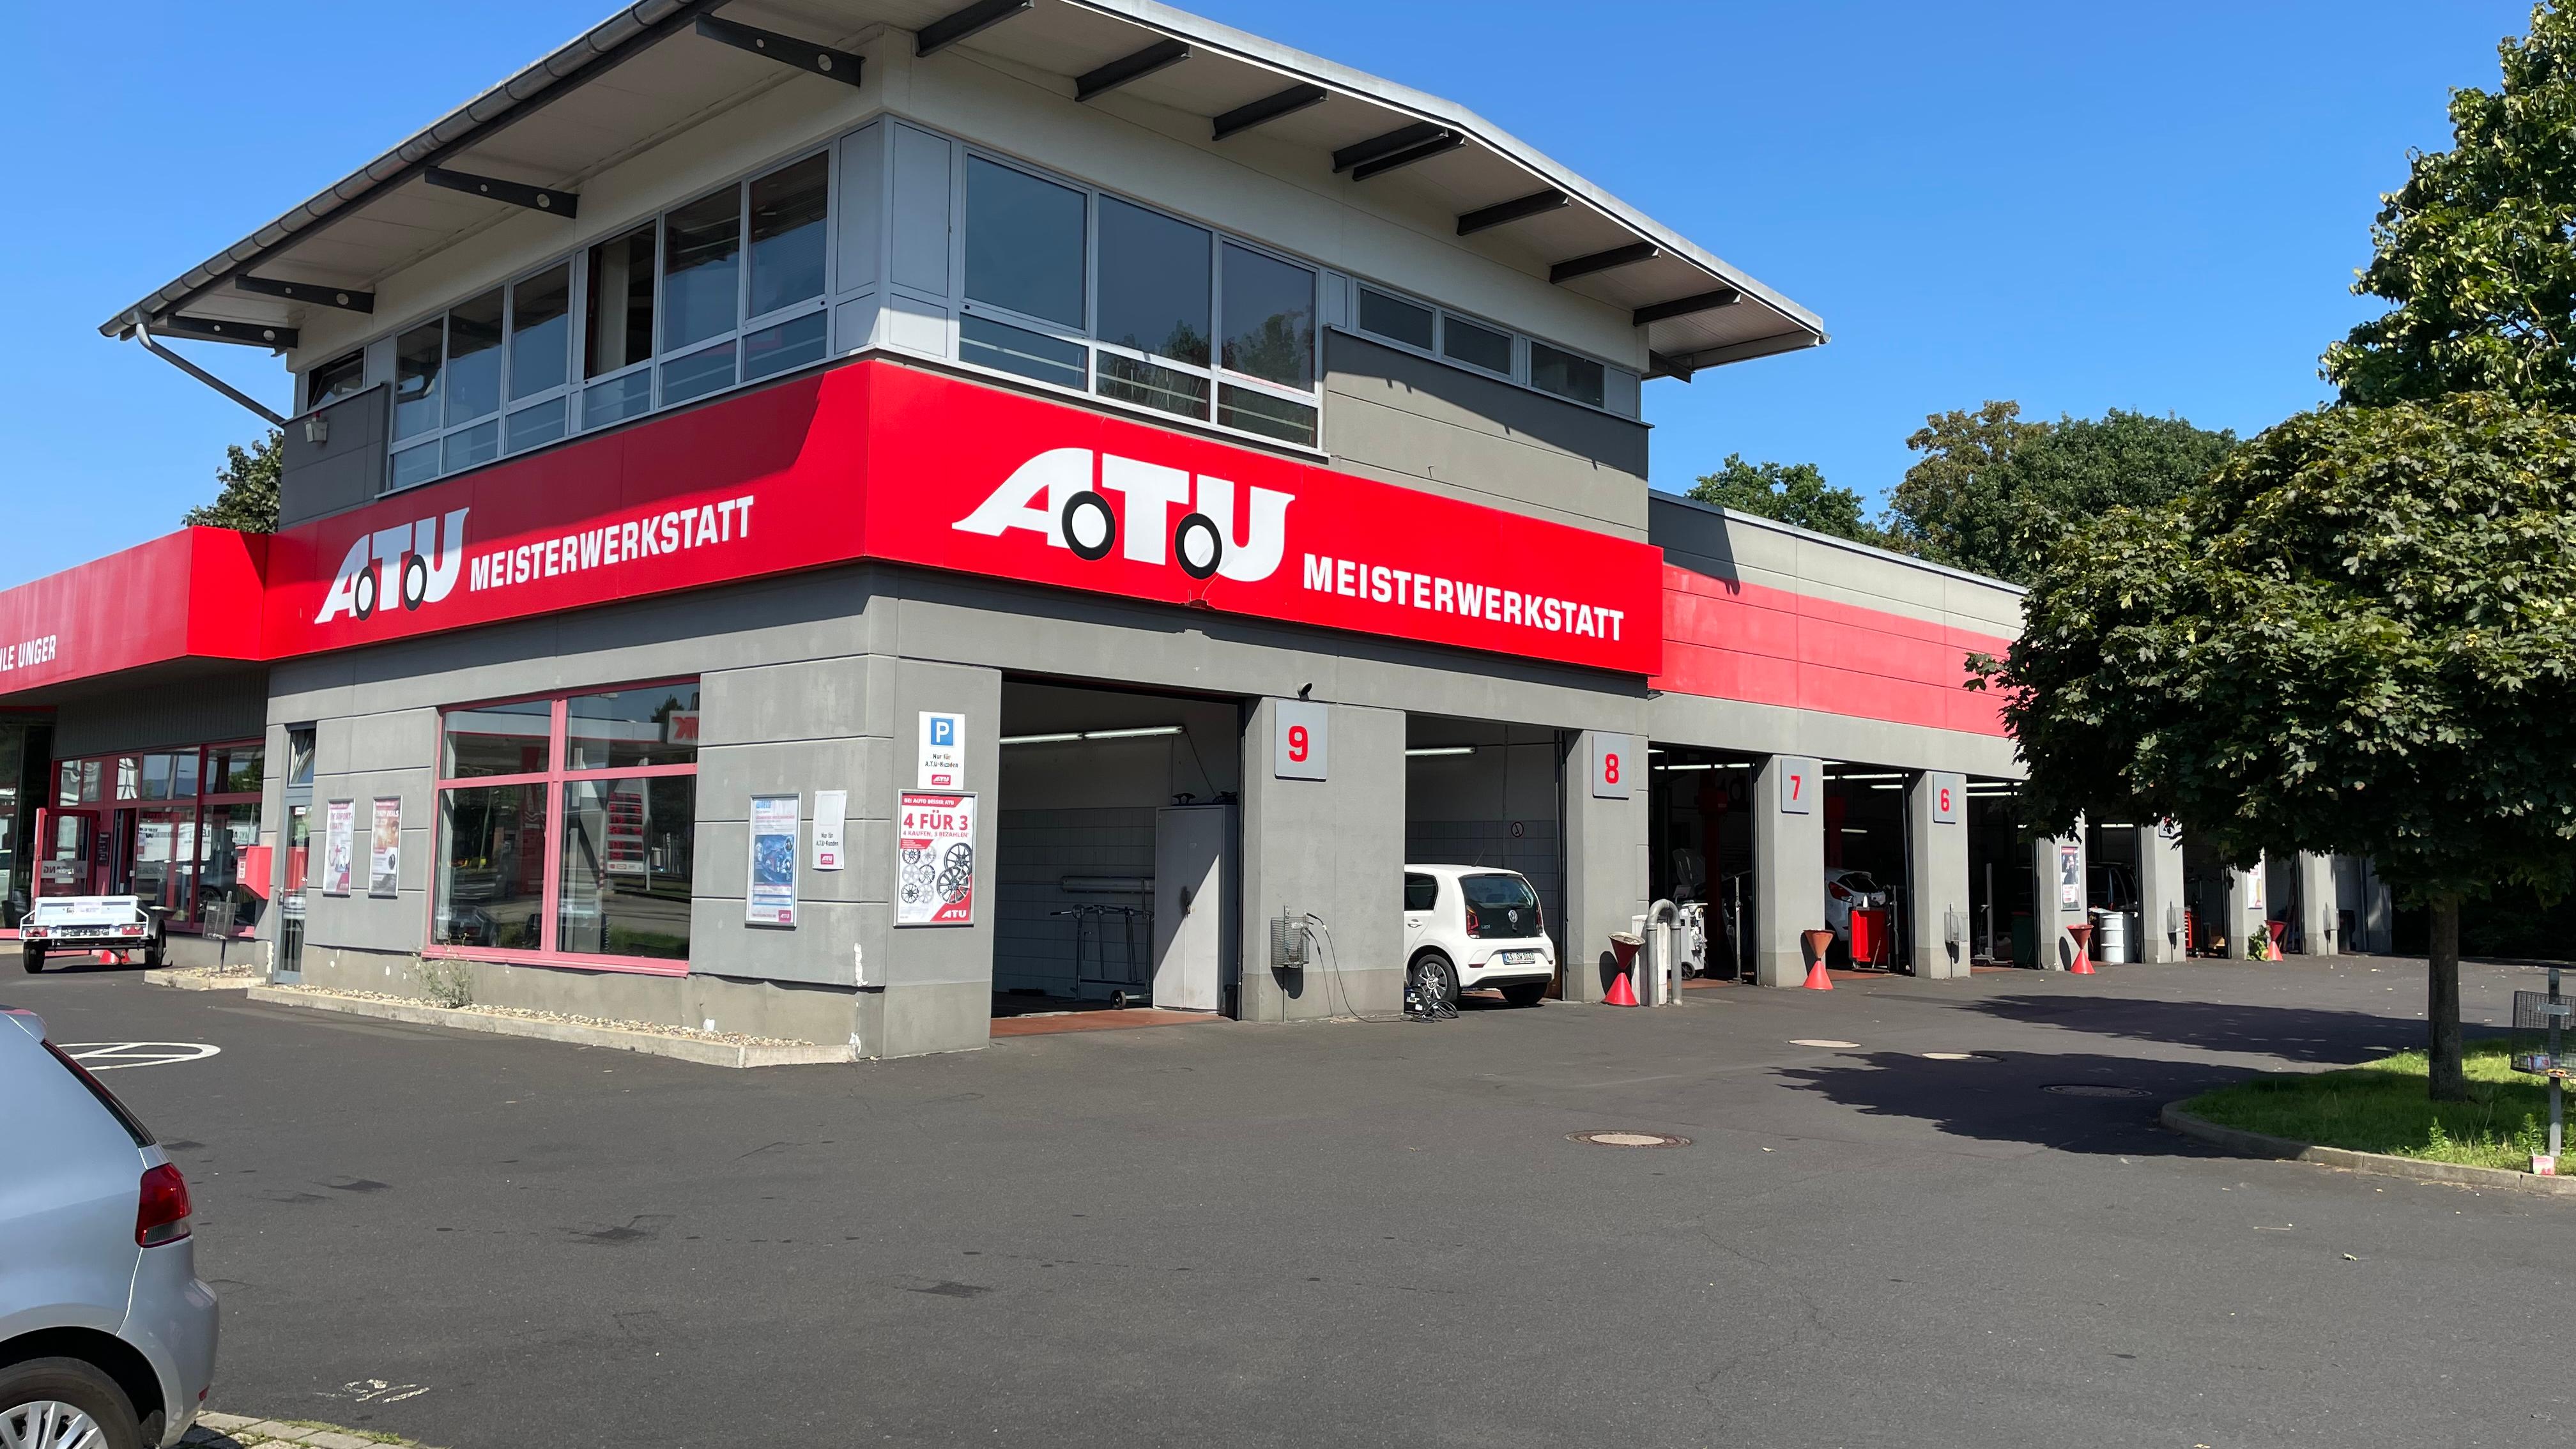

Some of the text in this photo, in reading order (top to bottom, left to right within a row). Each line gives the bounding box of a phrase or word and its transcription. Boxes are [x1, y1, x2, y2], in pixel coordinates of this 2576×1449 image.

[951, 447, 1625, 641] ATU MEISTERWERKSTATT
[314, 495, 754, 625] ATU MEISTERWERKSTATT
[18, 634, 56, 668] UNGER
[935, 721, 949, 743] P
[1289, 725, 1308, 762] 9
[1605, 753, 1619, 784] 8
[1790, 775, 1800, 801] 7
[1941, 788, 1950, 812] 6
[903, 809, 968, 831] 4 FÜR 3
[941, 910, 967, 918] ATU
